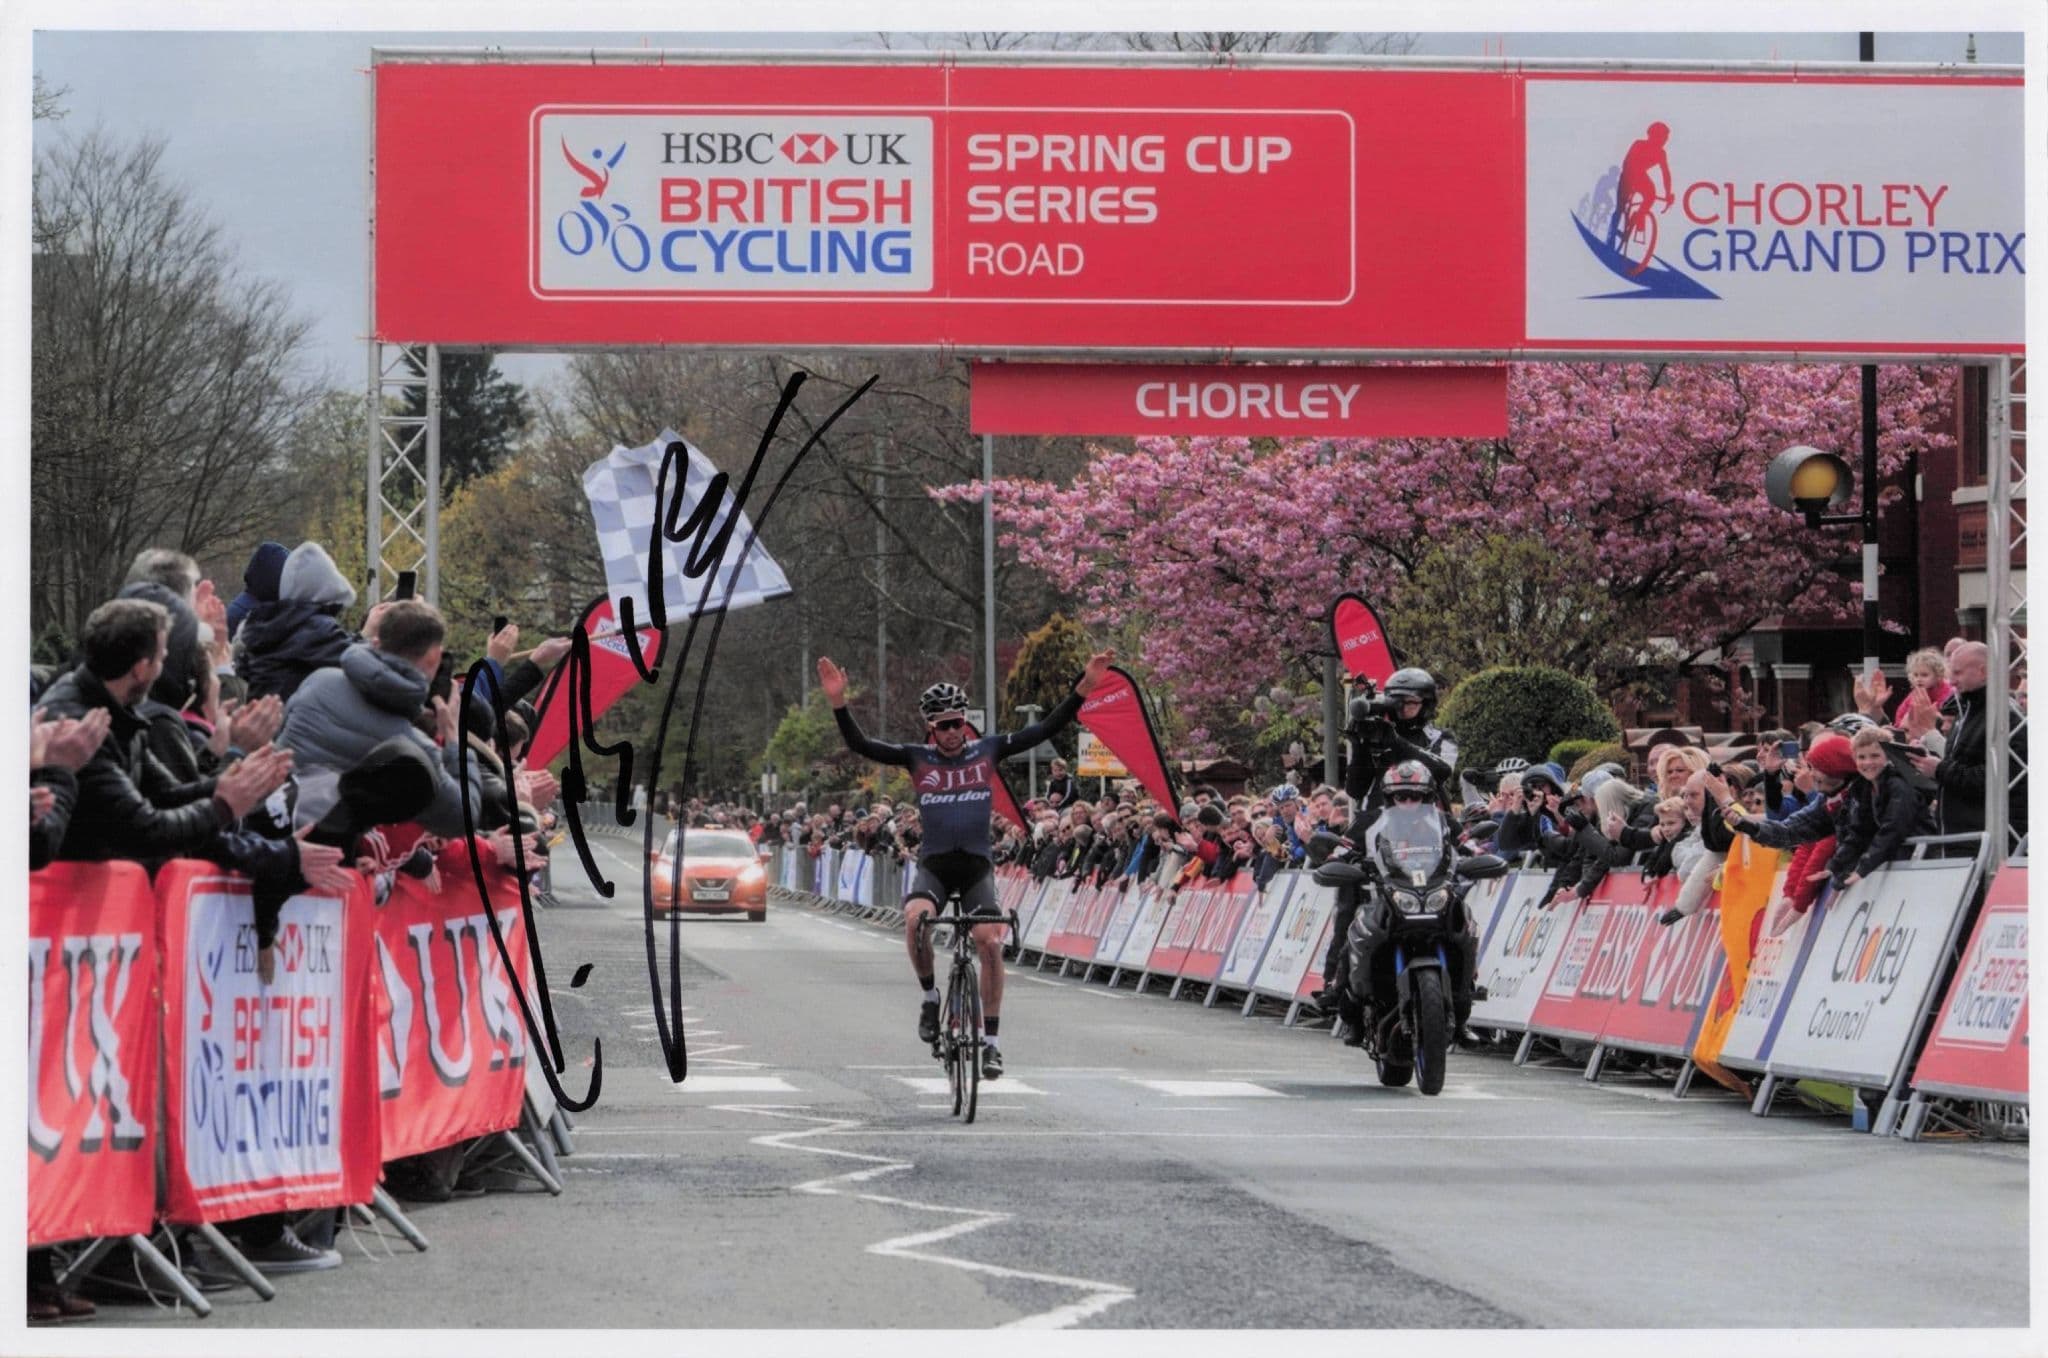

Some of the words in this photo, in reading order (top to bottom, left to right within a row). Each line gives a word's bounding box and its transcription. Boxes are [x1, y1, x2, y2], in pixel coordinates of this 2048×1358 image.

[662, 132, 775, 165] HSBC
[844, 133, 911, 166] UK
[967, 133, 1165, 173] SPRING
[1186, 136, 1292, 173] CUP
[660, 177, 912, 225] BRITISH
[967, 185, 1158, 224] SERIES
[1682, 181, 1949, 227] CHORLEY
[660, 229, 912, 274] CYCLING
[967, 242, 1085, 276] ROAD
[1682, 228, 1886, 273] GRAND
[1904, 231, 2026, 275] PRIX
[1135, 382, 1361, 419] CHORLEY
[920, 790, 991, 806] Condor
[942, 762, 987, 791] JLT
[306, 924, 332, 973] UK
[1503, 897, 1557, 973] Chorley
[1832, 899, 1917, 1004] Chorley
[408, 907, 526, 1088] UK
[1807, 997, 1874, 1041] Council
[1963, 995, 2020, 1029] CYCLING
